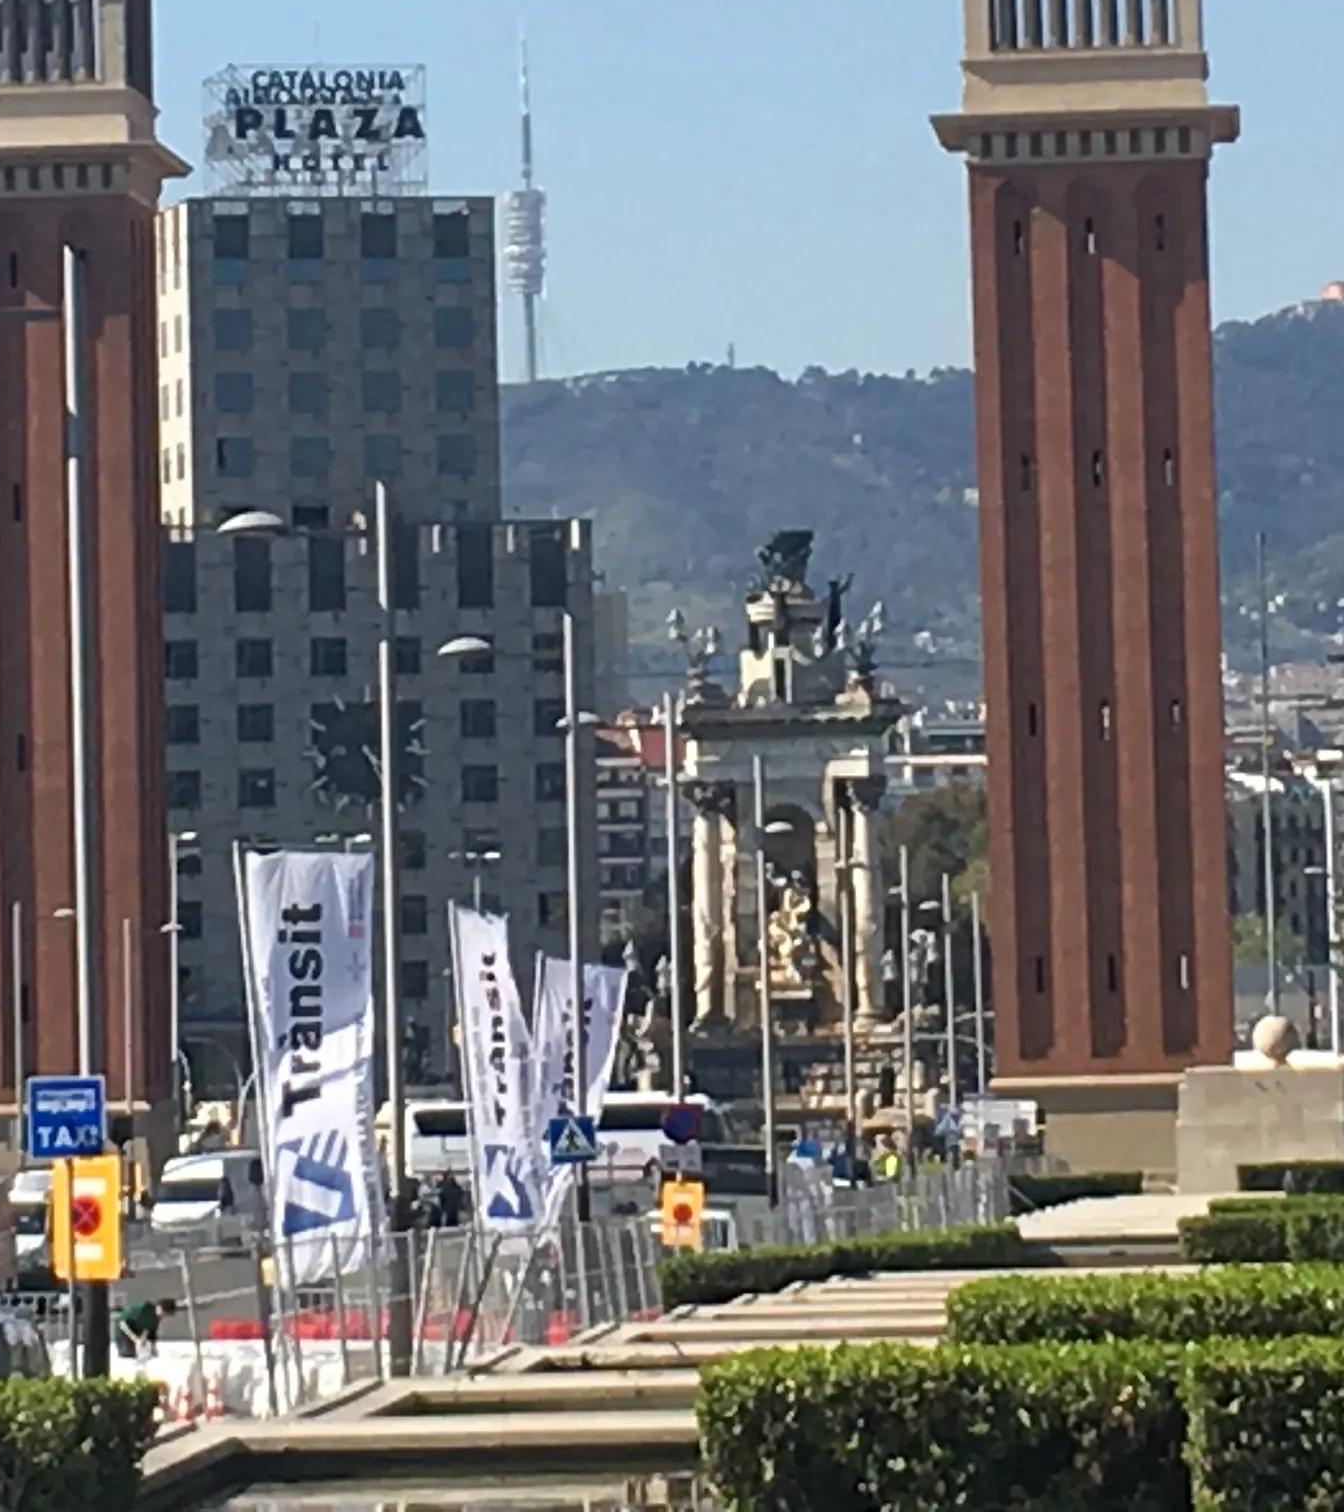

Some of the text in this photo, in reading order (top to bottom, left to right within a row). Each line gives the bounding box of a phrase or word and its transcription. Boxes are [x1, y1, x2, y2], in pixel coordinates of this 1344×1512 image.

[251, 70, 405, 91] CATALONIA
[235, 106, 426, 139] PLAZA
[272, 152, 389, 172] HOTEL
[37, 1124, 98, 1149] TAXI
